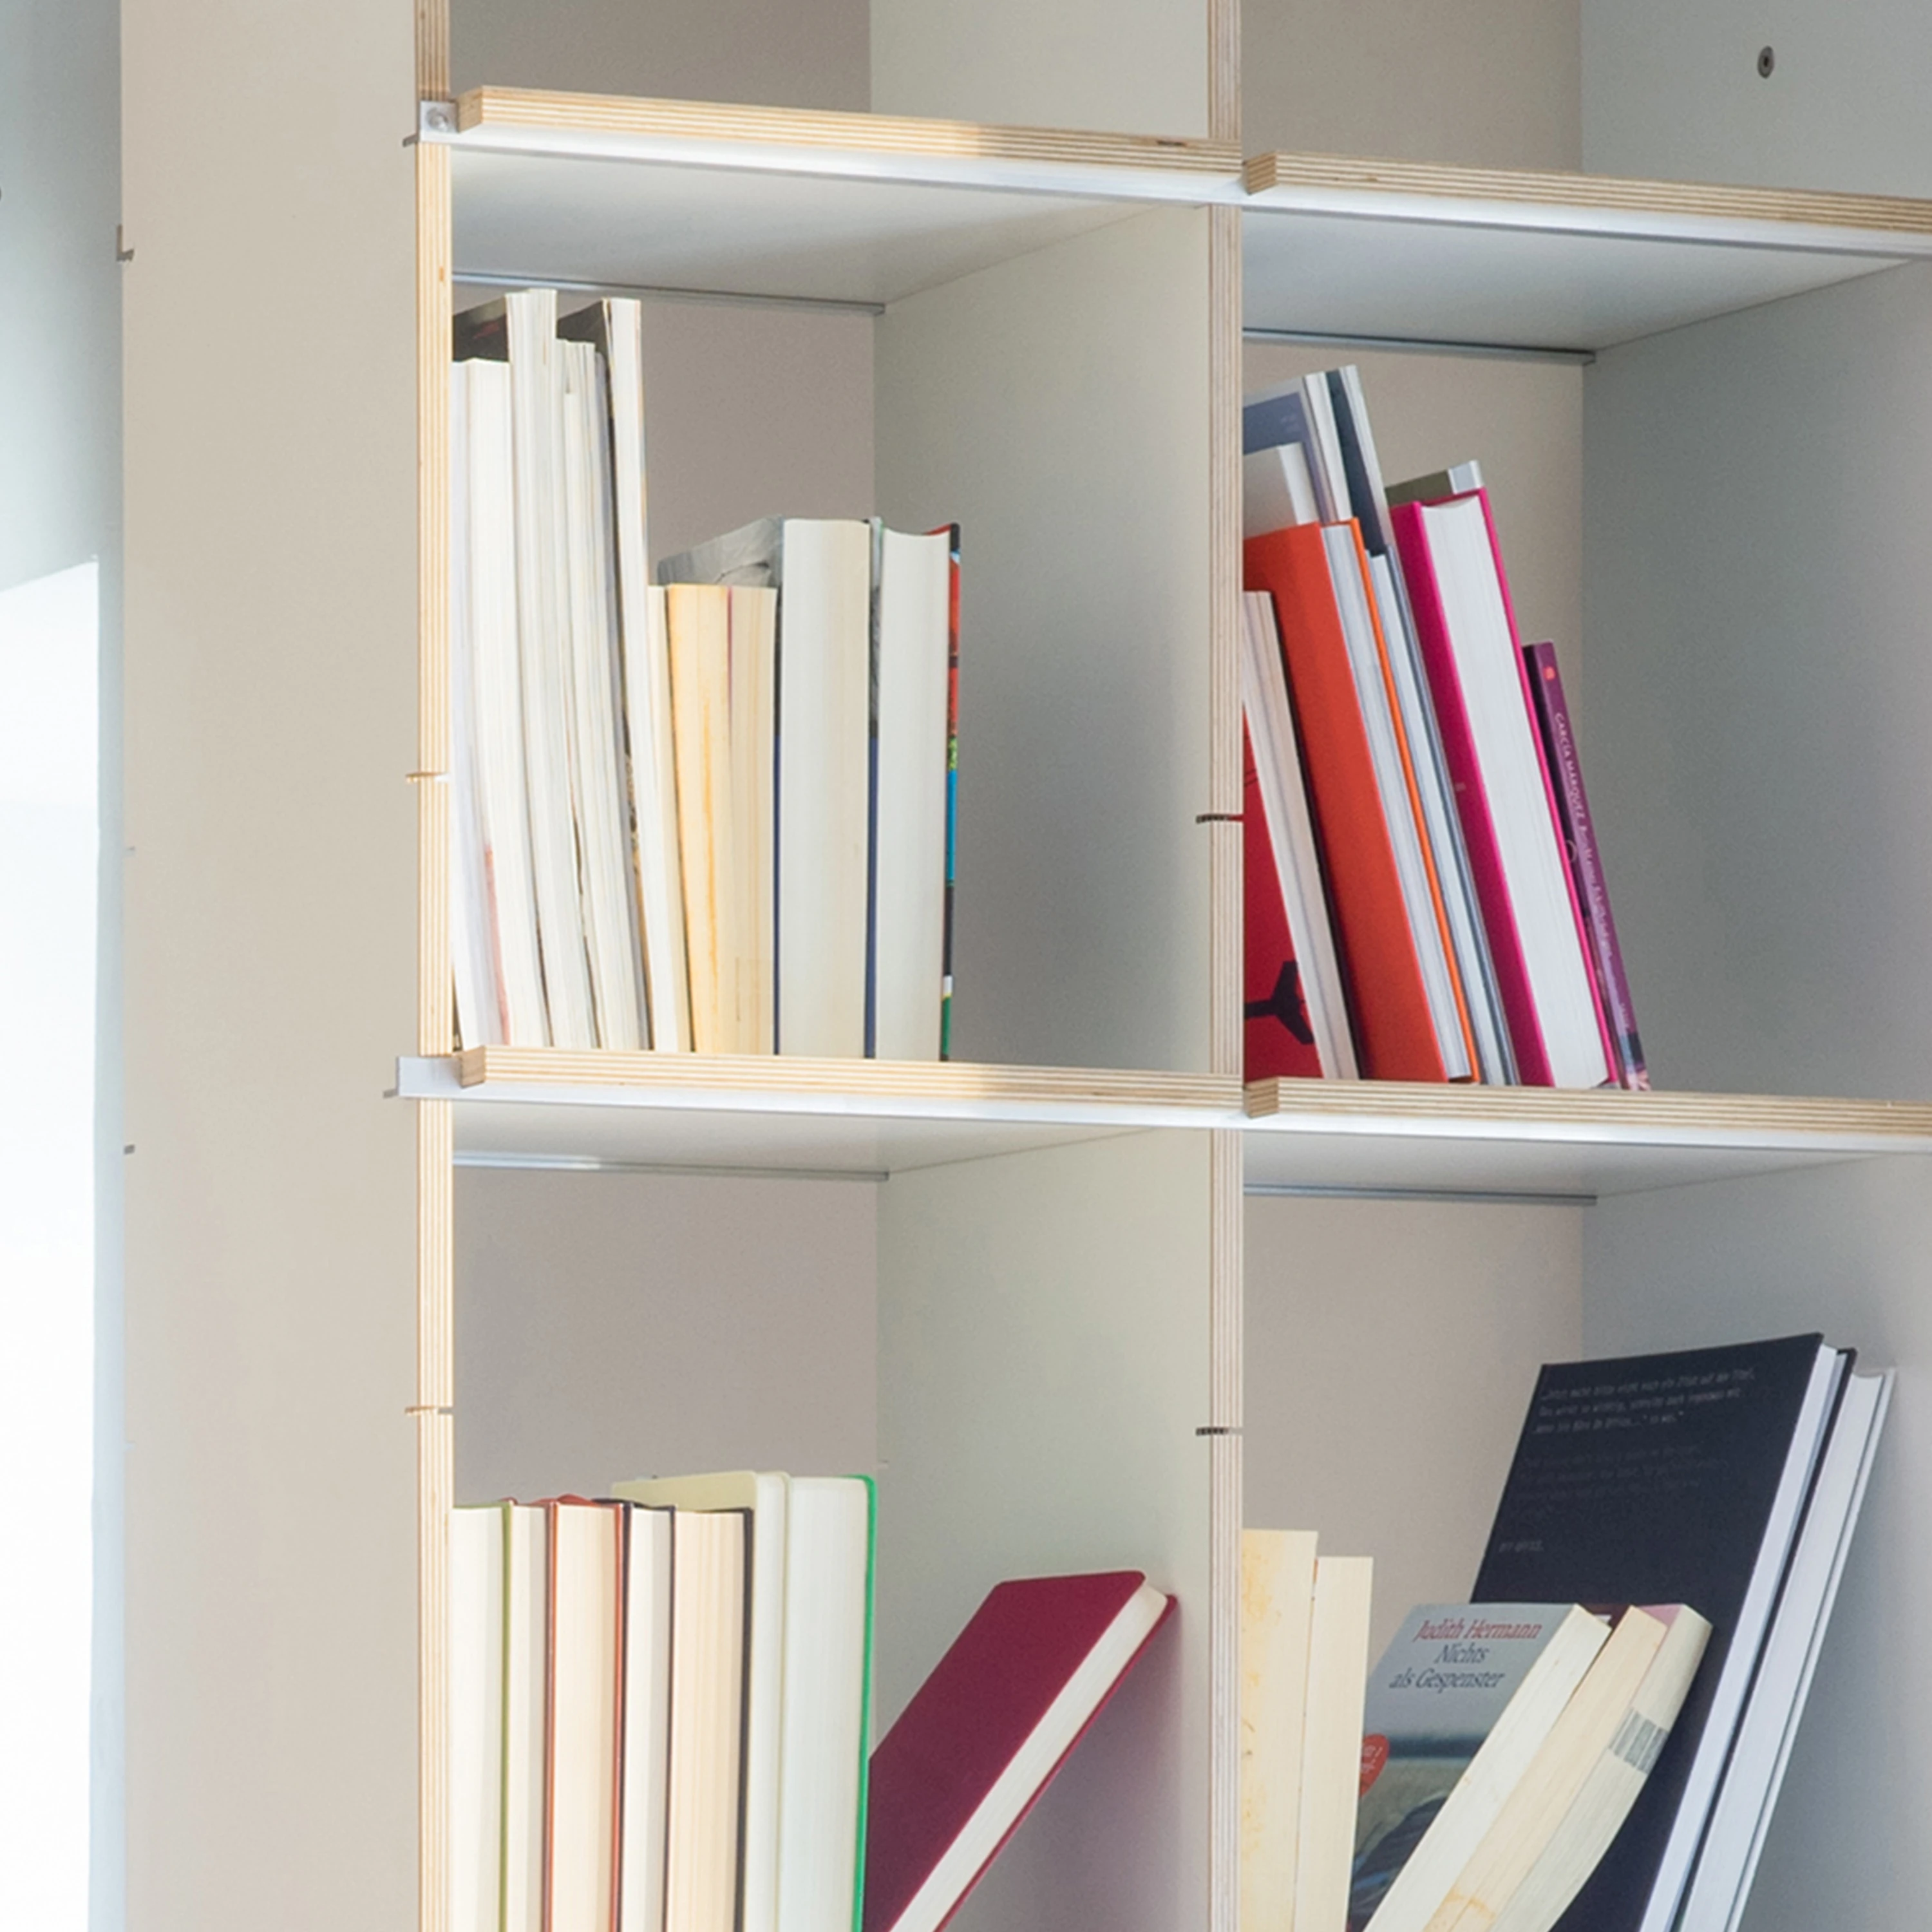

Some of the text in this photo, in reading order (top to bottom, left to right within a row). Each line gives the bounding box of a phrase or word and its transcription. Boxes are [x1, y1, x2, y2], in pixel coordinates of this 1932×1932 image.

[1413, 1618, 1542, 1642] Judith Hermann
[1434, 1643, 1490, 1663] Nichts
[1389, 1668, 1505, 1693] als Gespenster
